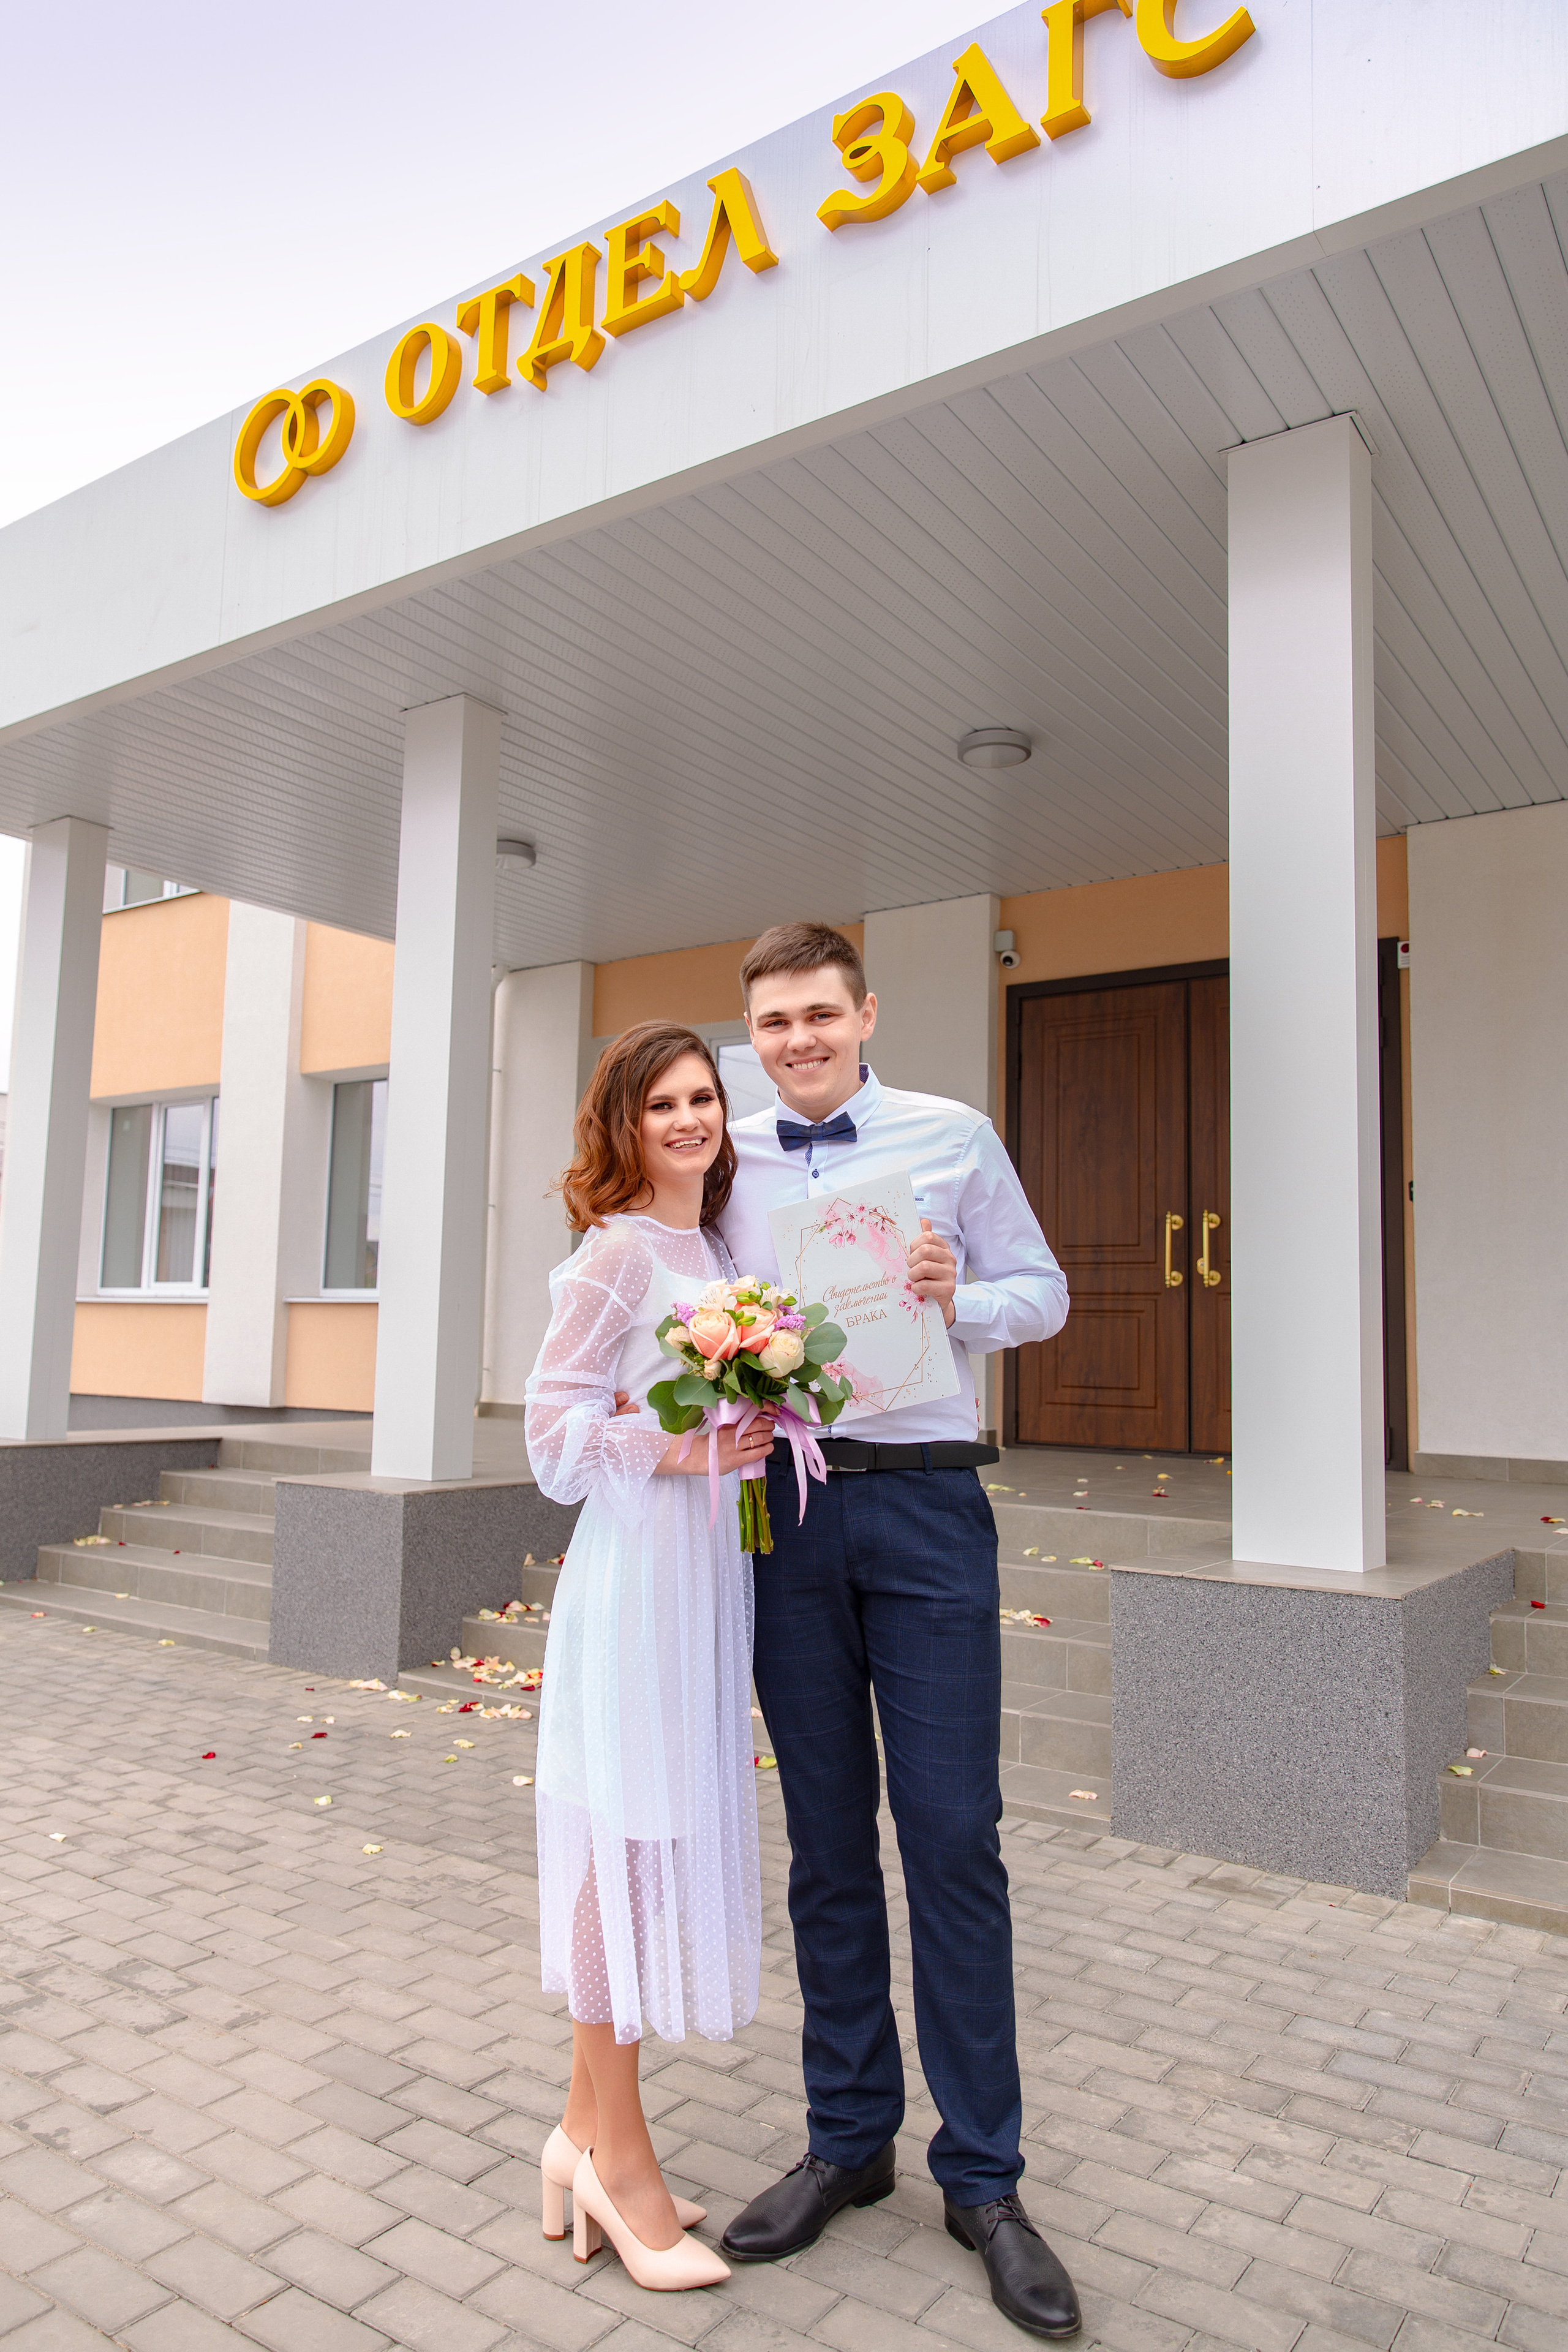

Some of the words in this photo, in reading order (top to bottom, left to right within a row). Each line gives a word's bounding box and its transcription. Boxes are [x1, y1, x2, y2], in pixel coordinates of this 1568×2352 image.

[385, 167, 778, 426] ОТДЕЛ
[823, 1271, 890, 1303] Свидетельство
[891, 1275, 897, 1284] о
[834, 1292, 888, 1318] заключении
[845, 1308, 888, 1328] БРАКА
